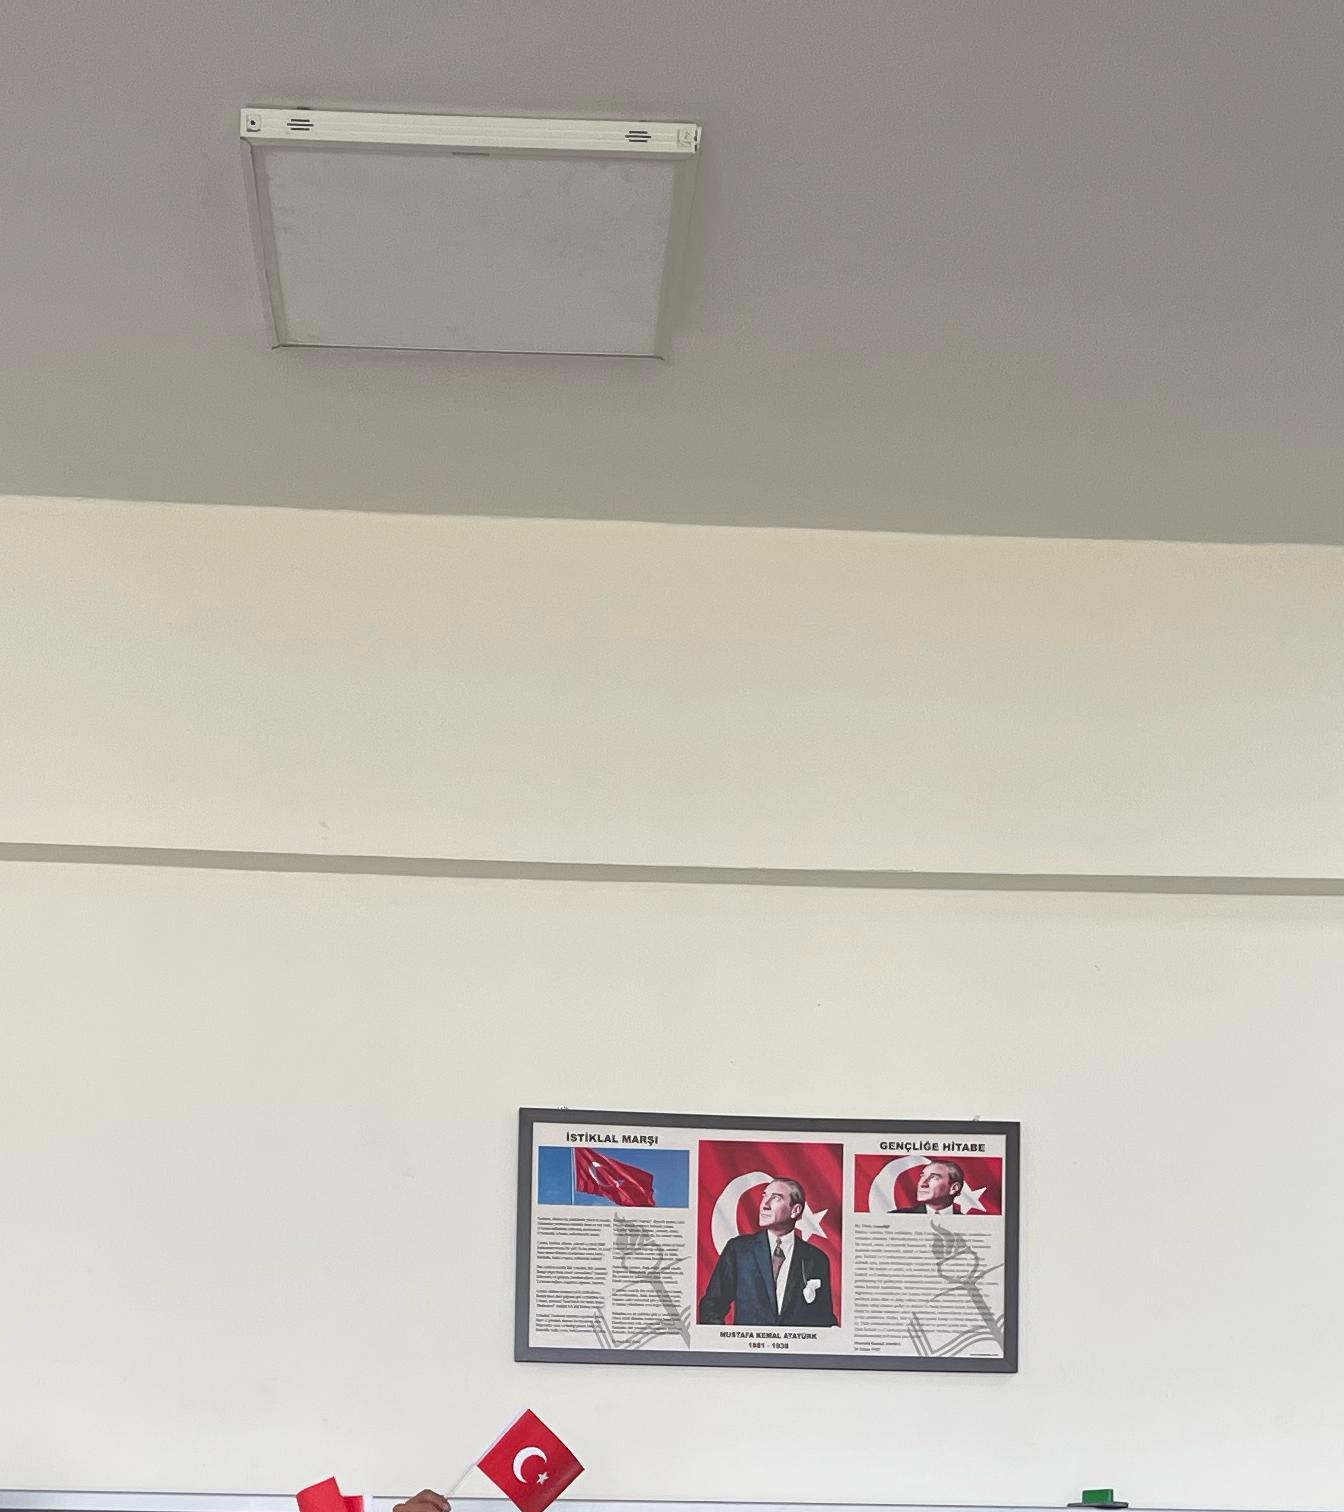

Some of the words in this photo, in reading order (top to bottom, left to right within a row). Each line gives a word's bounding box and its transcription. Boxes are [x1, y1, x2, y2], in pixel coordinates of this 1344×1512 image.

[566, 1131, 618, 1143] İSTİKLAL
[622, 1135, 658, 1146] MARŞI
[879, 1141, 940, 1152] GENÇLİĞE
[942, 1141, 986, 1152] HİTABE
[719, 1331, 755, 1339] MUSTAFA
